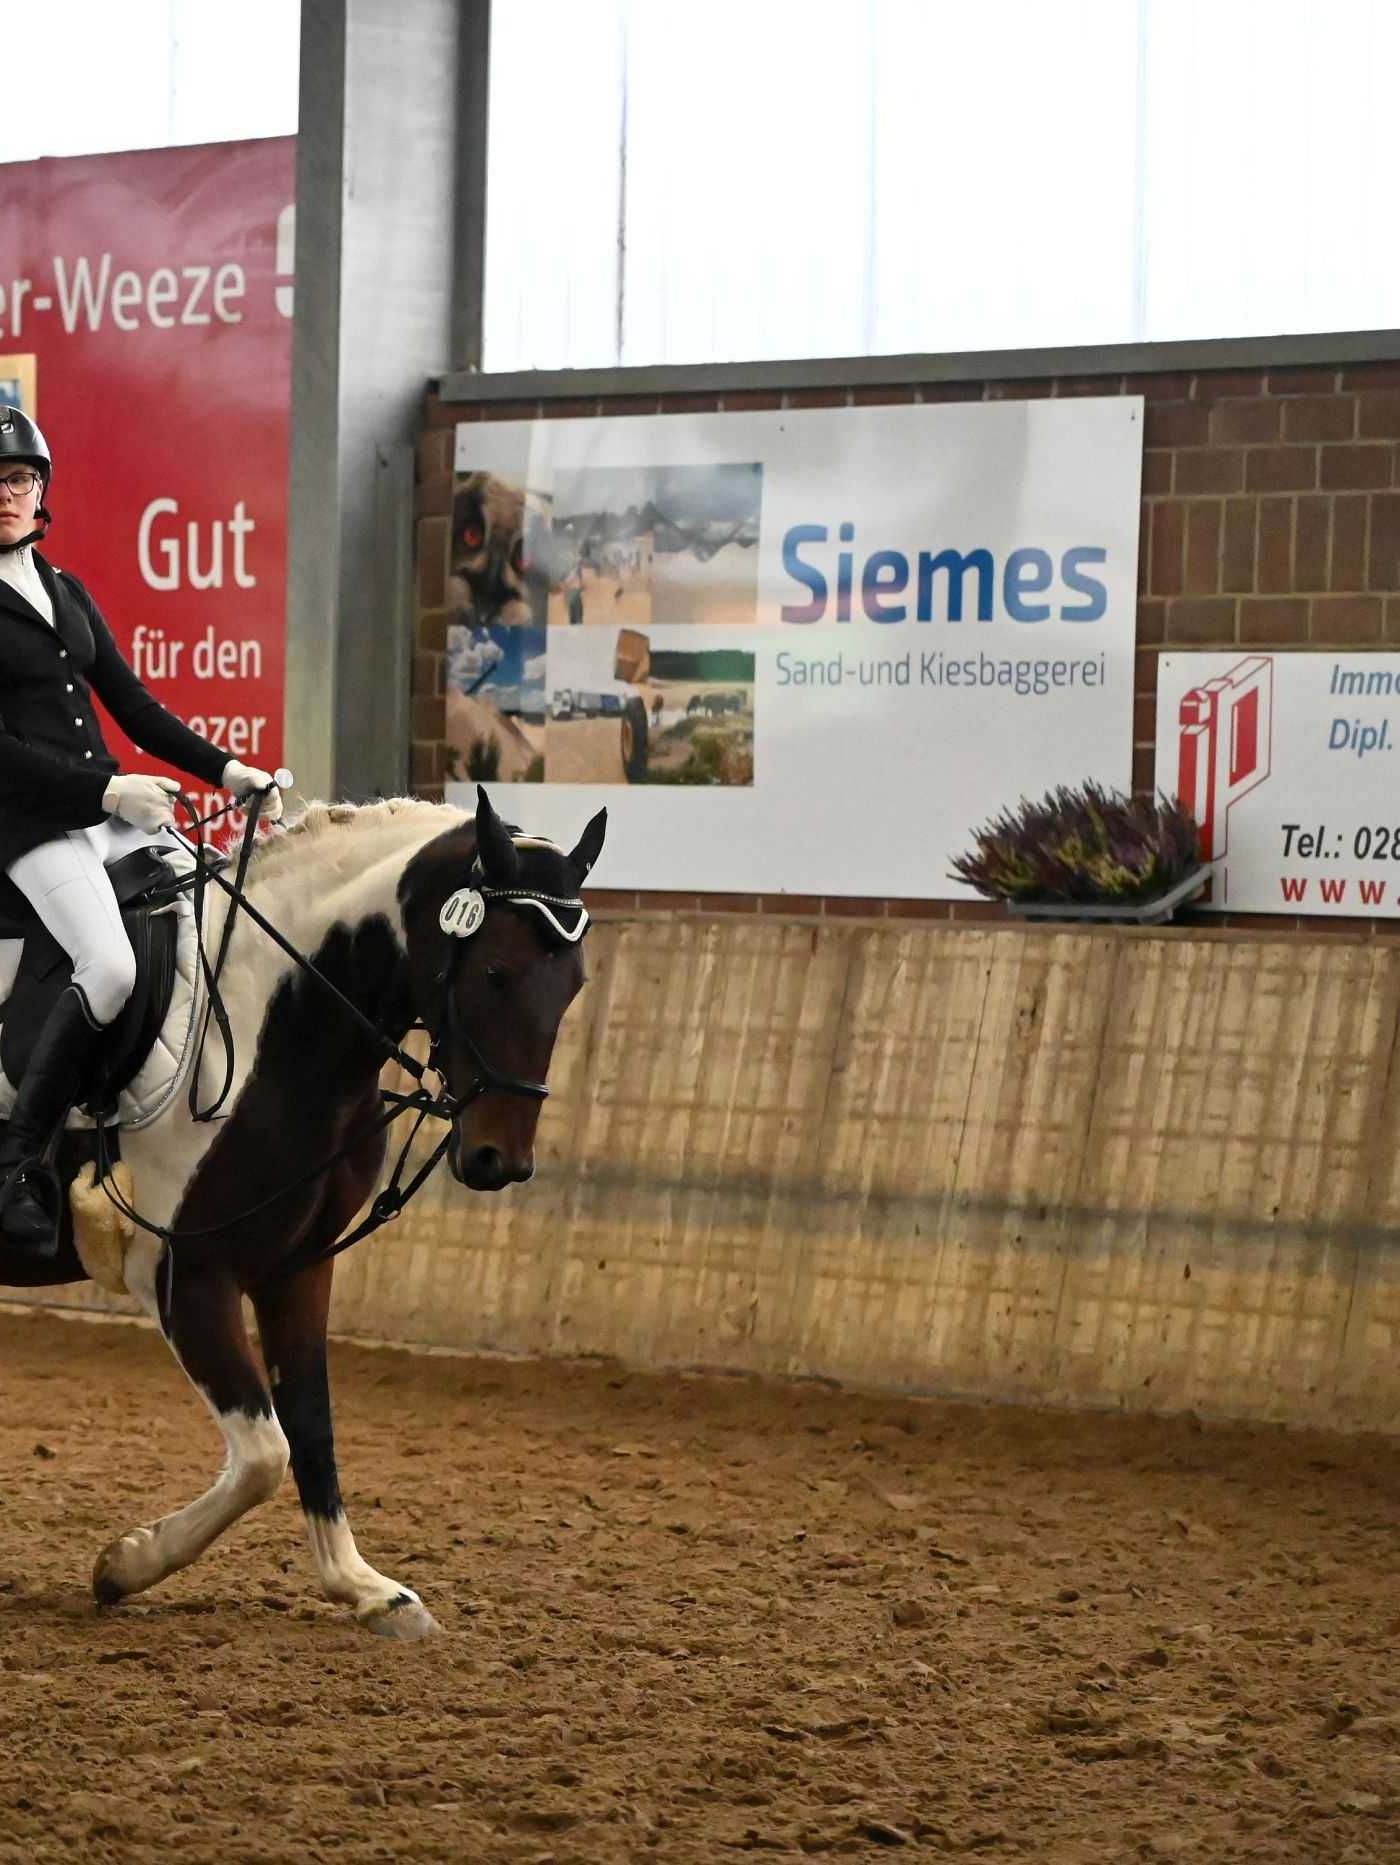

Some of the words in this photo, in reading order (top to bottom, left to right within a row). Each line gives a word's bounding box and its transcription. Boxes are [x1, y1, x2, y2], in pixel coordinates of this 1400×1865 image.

[138, 498, 256, 591] Gut
[780, 521, 1108, 625] Siemes
[132, 625, 184, 679] für
[192, 626, 261, 679] den
[920, 651, 1106, 695] Kiesbaggerei
[1330, 664, 1400, 695] Imm
[1329, 719, 1393, 759] Dipl.
[1281, 825, 1343, 859] Tel.:
